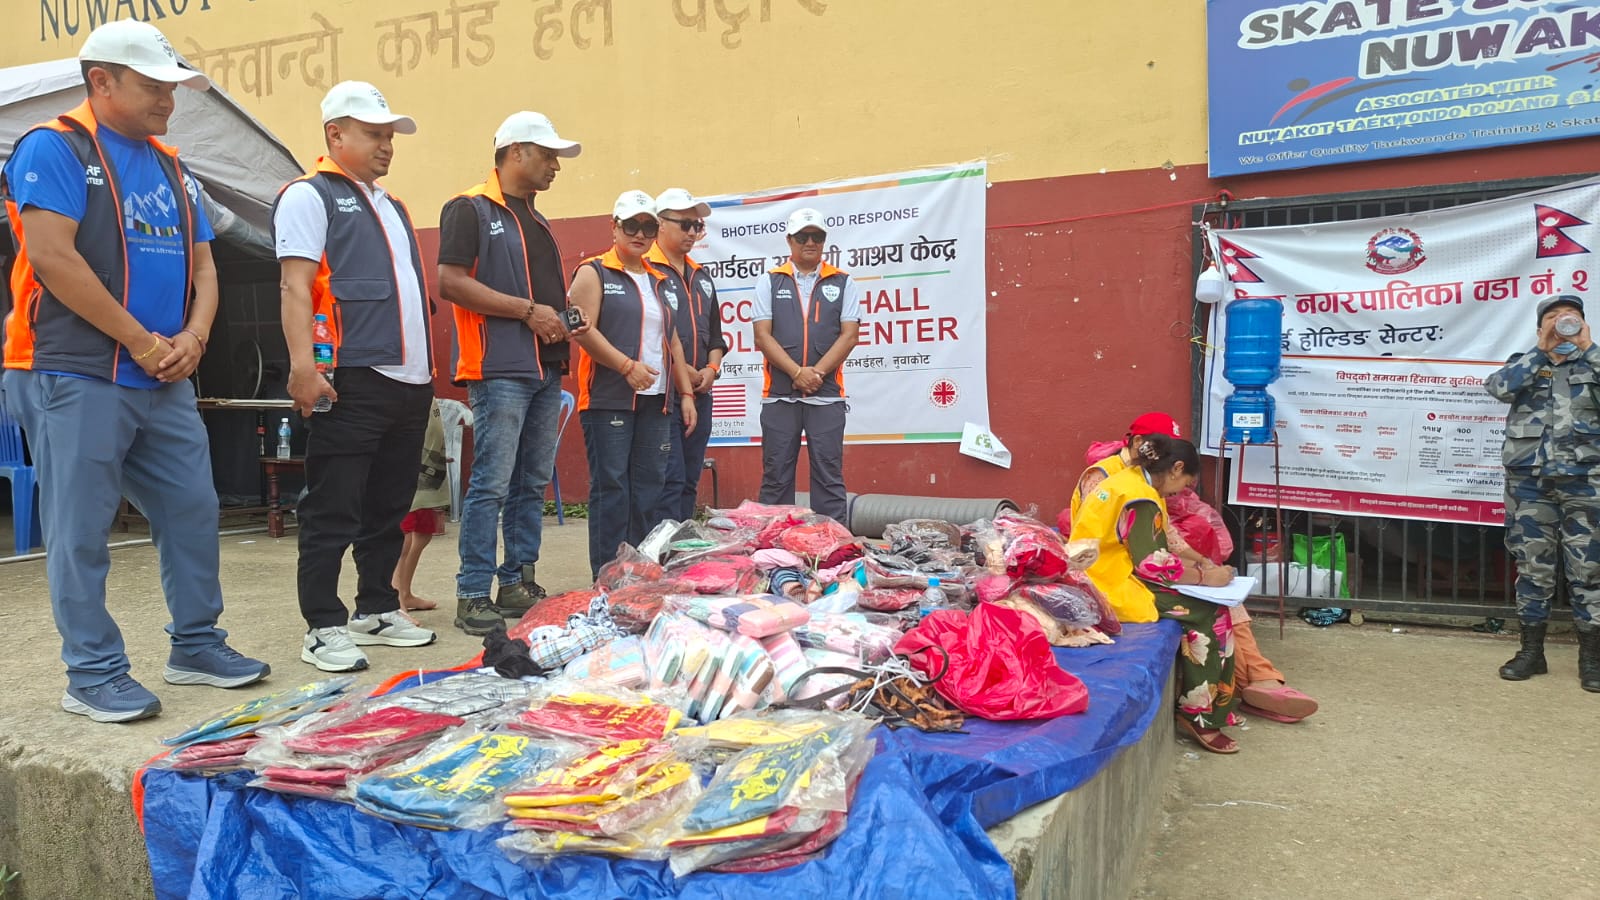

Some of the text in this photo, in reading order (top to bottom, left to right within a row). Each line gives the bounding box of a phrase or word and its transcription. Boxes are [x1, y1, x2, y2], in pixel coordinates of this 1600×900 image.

[1244, 0, 1444, 45] SKATE
[1357, 84, 1484, 112] ASSOCIATED
[1240, 122, 1333, 145] NUWAKOT
[1338, 107, 1462, 131] TAEKWONDO
[1468, 96, 1557, 116] DOJANG
[1239, 156, 1263, 166] We
[1266, 150, 1306, 161] Offer
[1311, 143, 1368, 158] Quality
[1371, 132, 1466, 150] Taekwondo
[1470, 122, 1541, 138] Training
[1545, 121, 1557, 130] &
[721, 221, 789, 239] BHOTEKOS
[848, 207, 920, 226] RESPONSE
[847, 243, 904, 268] आश्रय
[909, 235, 958, 262] केन्द्र
[859, 287, 930, 314] HALL
[1294, 279, 1464, 315] नगरपालिका
[1473, 276, 1520, 301] वडा
[1571, 269, 1589, 292] २
[856, 316, 959, 346] ENTER
[1299, 327, 1371, 351] होल्डिङ
[892, 352, 931, 369] नुवाकोट
[733, 419, 745, 427] the
